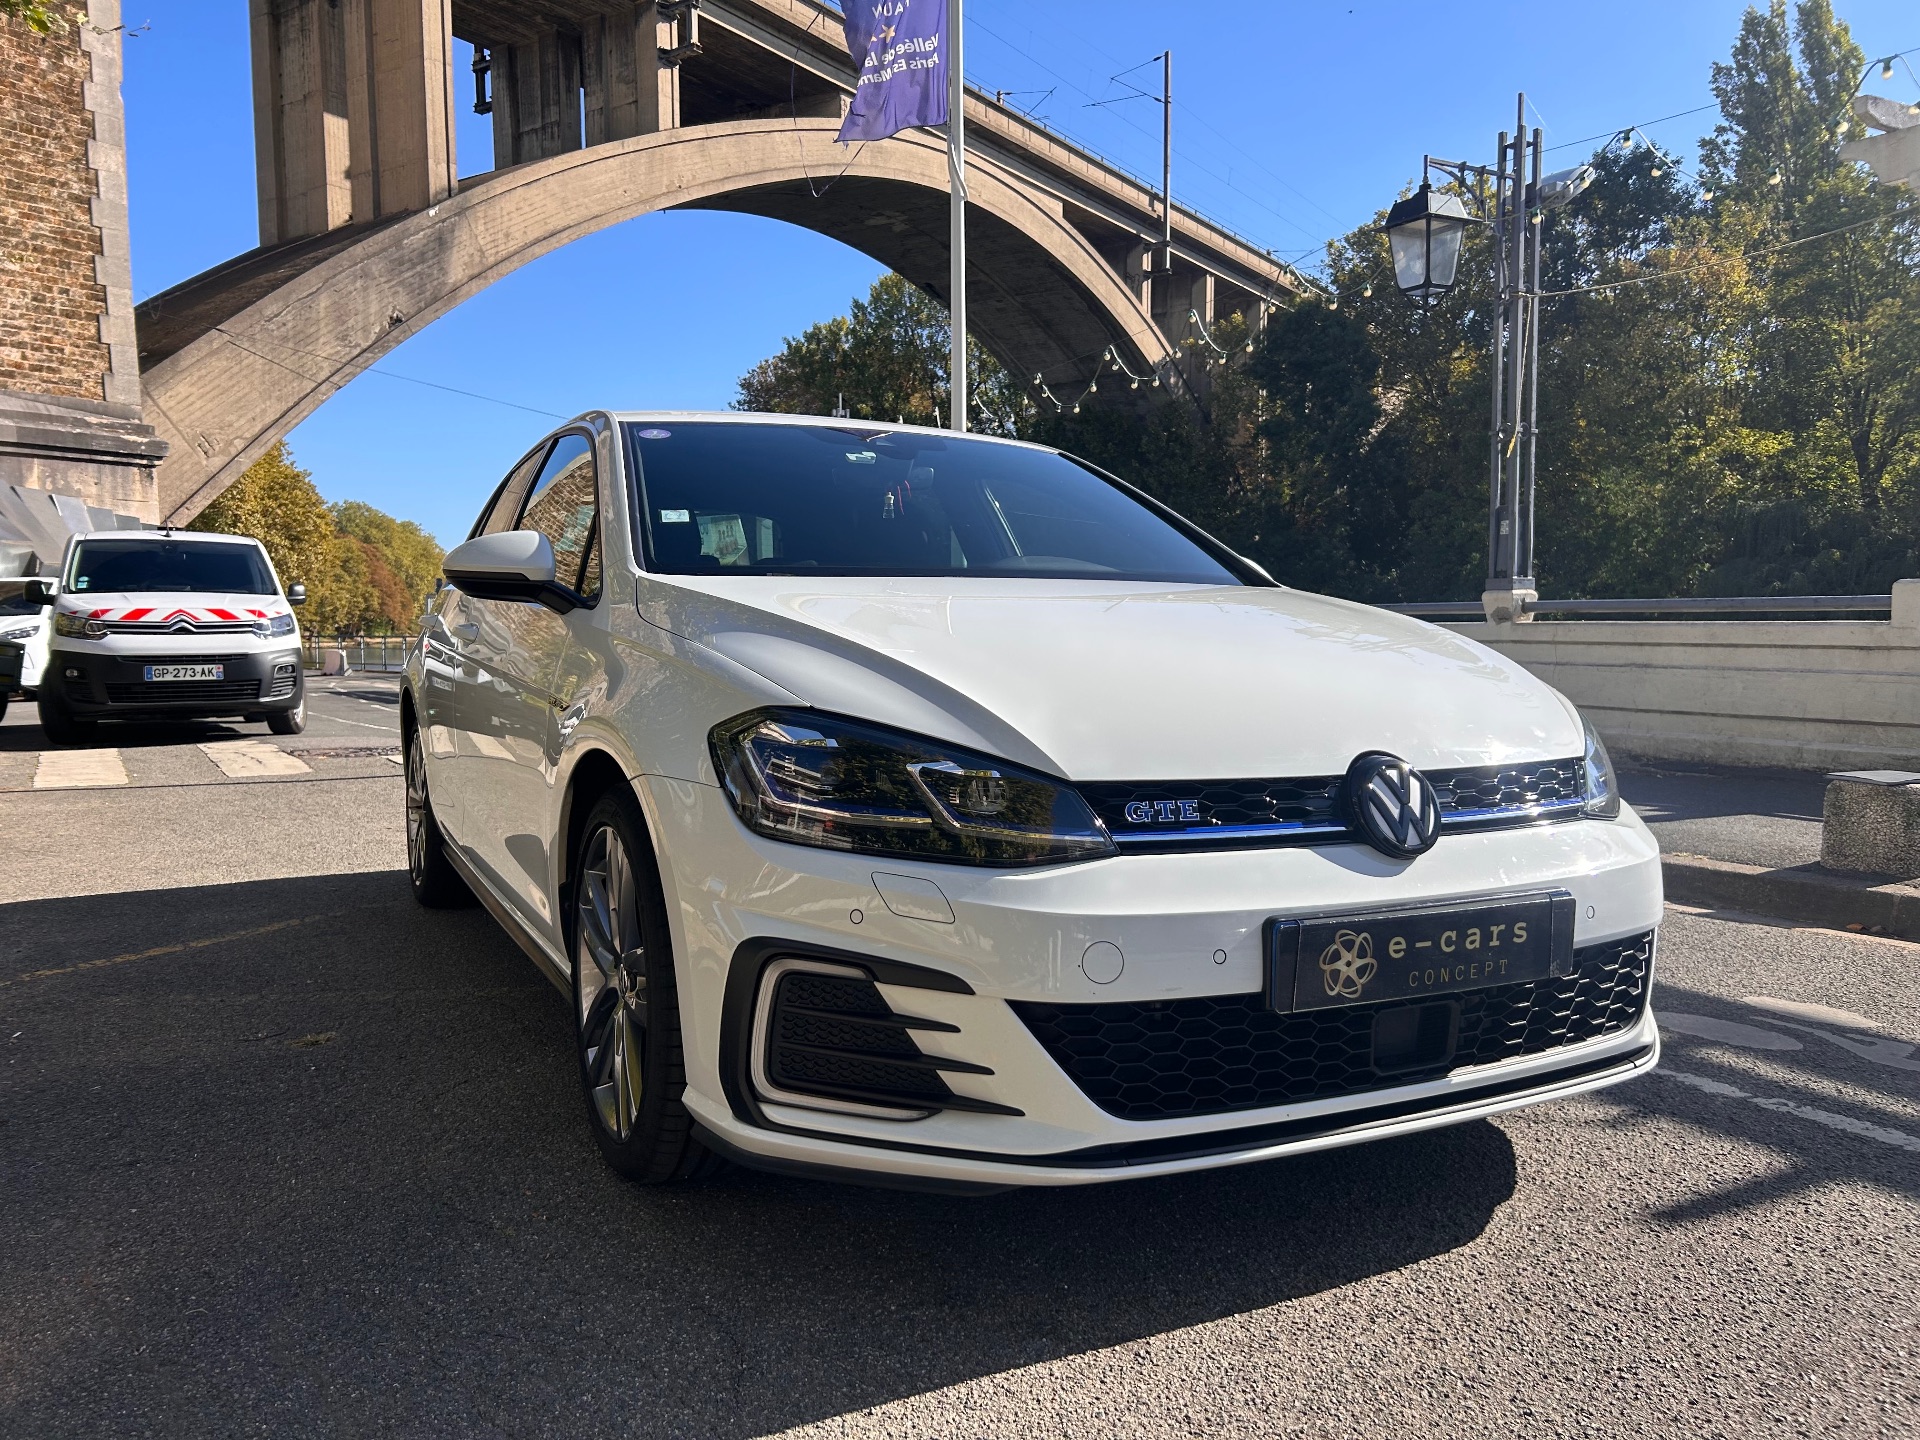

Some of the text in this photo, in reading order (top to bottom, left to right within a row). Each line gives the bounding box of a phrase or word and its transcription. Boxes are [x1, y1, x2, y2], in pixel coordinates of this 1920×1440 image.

[153, 667, 215, 679] GP-273-AK
[1124, 799, 1200, 823] GTE
[1388, 921, 1529, 959] e-cars
[1408, 959, 1509, 987] CONCEPT
